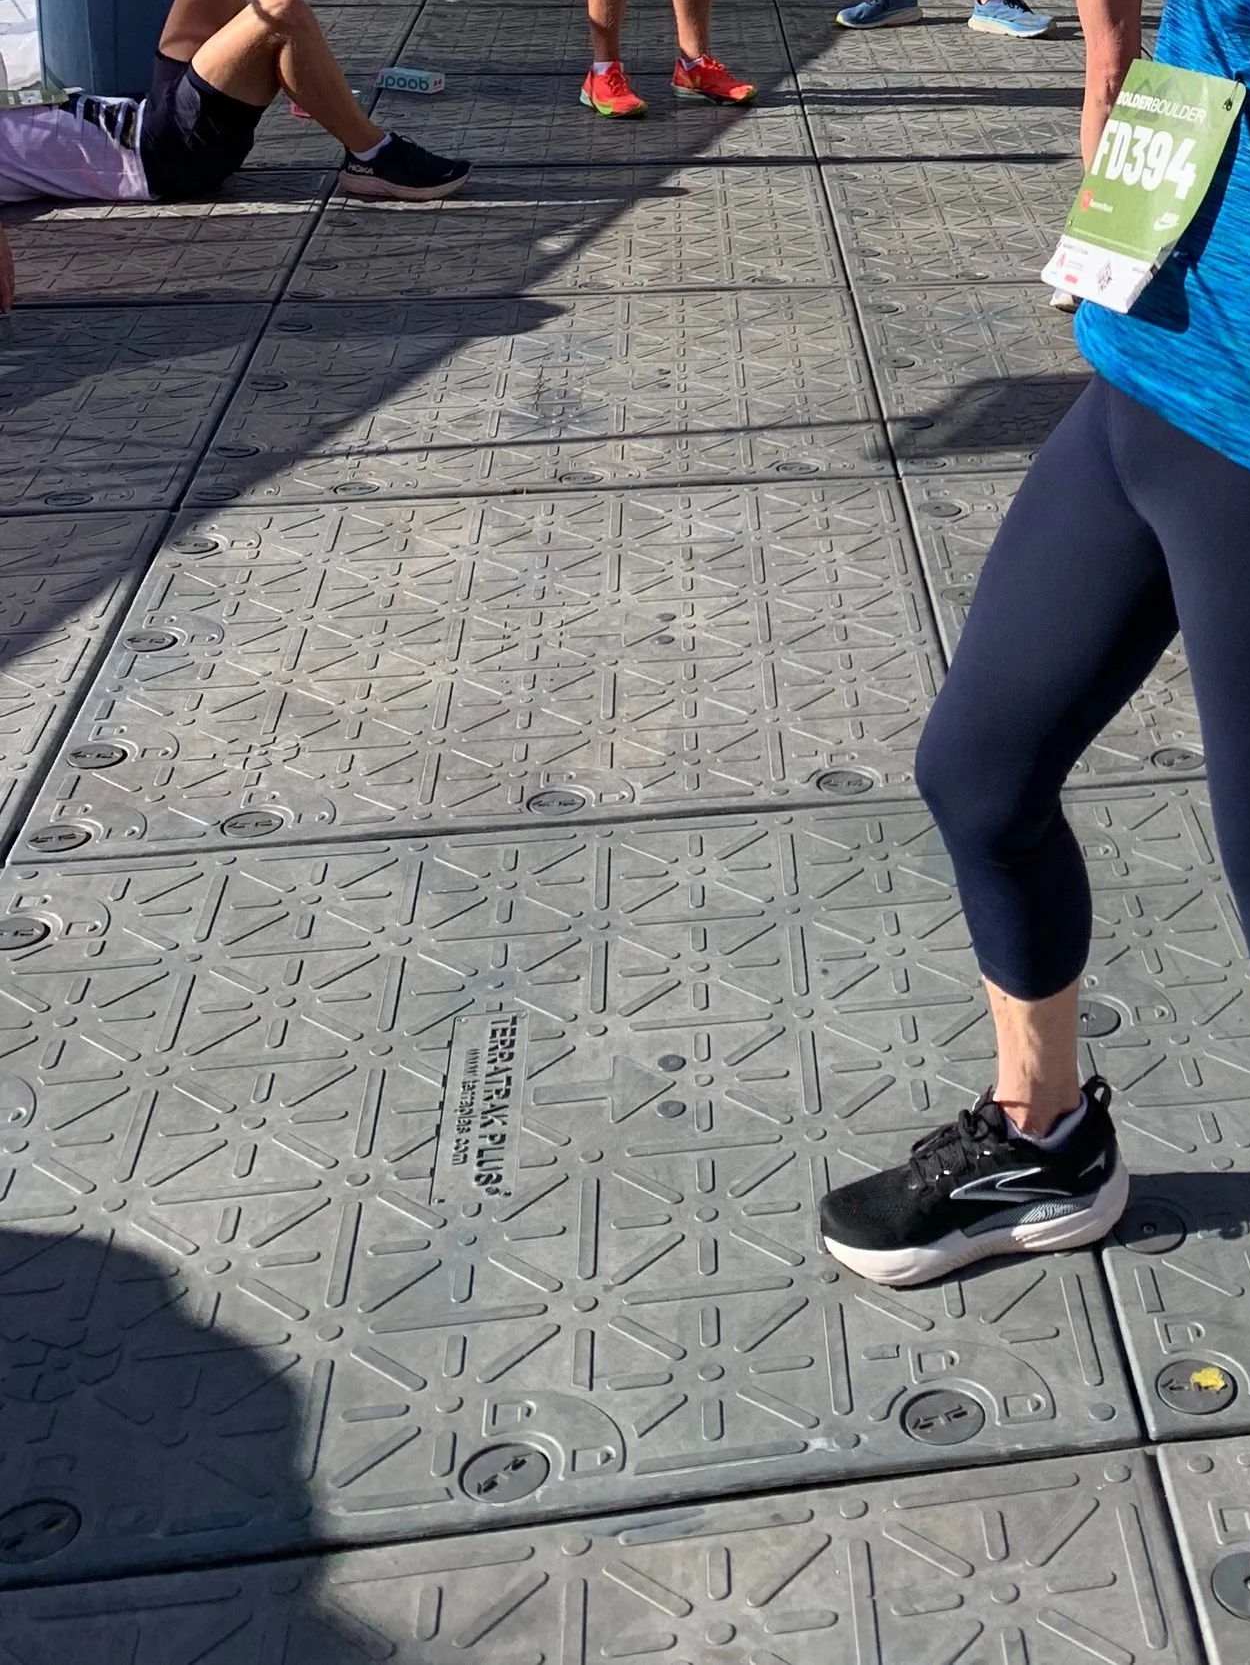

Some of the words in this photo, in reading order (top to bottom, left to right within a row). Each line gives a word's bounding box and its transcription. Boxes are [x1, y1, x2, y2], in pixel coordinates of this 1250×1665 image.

[1116, 90, 1207, 124] BOLDERBOULDER
[1090, 118, 1196, 200] FD394
[485, 1016, 517, 1133] TERRATRAK
